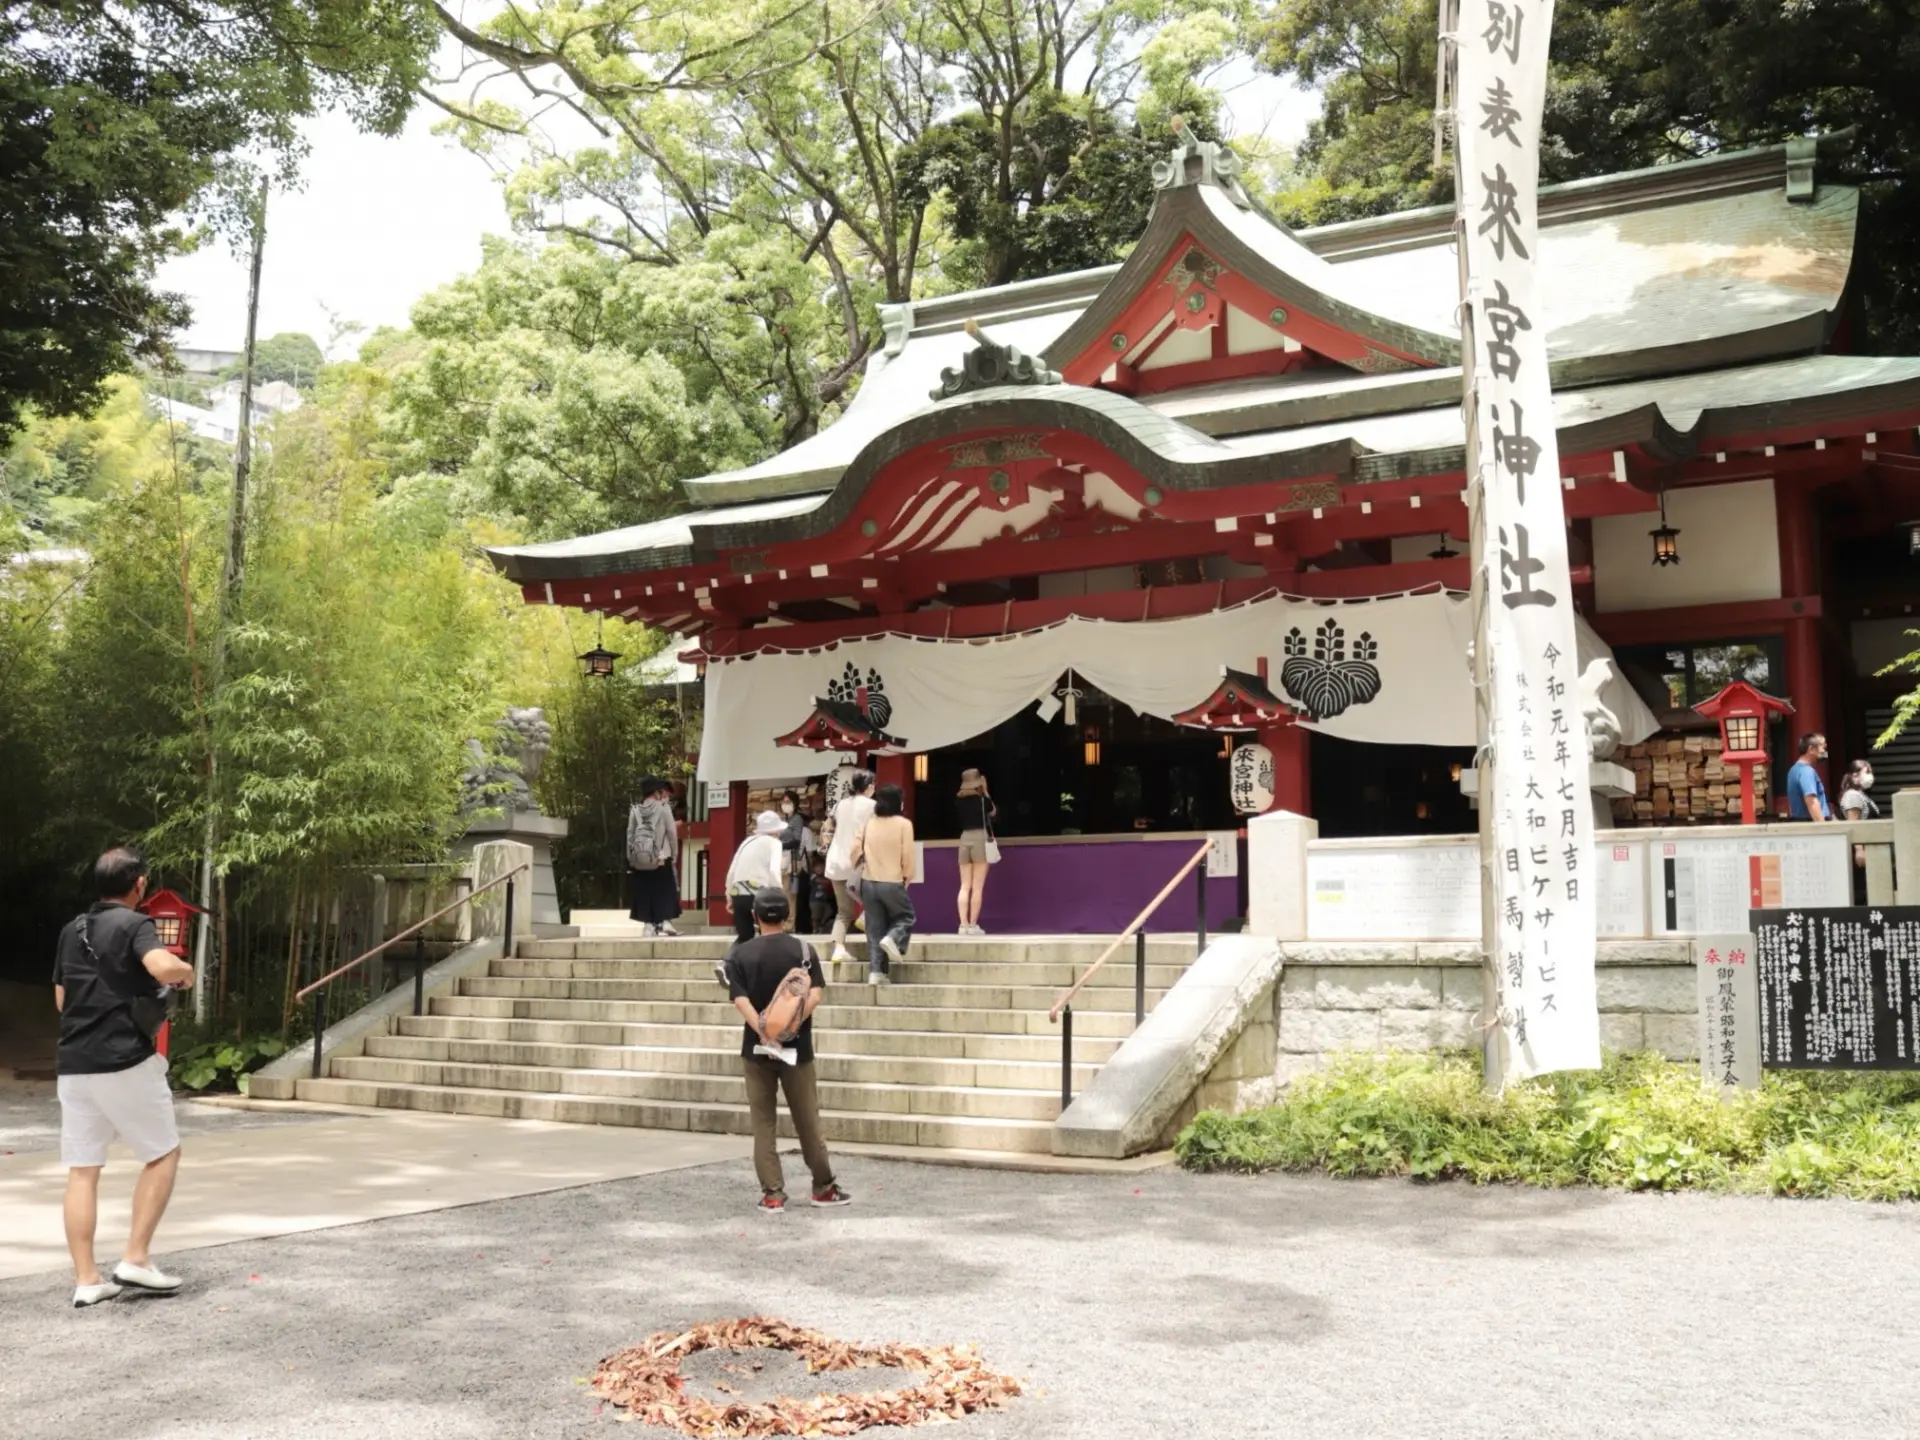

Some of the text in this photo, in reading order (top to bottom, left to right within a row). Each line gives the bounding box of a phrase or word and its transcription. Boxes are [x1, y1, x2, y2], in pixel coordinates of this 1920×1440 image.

[1543, 642, 1579, 902] 令和元年七月吉日
[1704, 948, 1746, 965] 奉納
